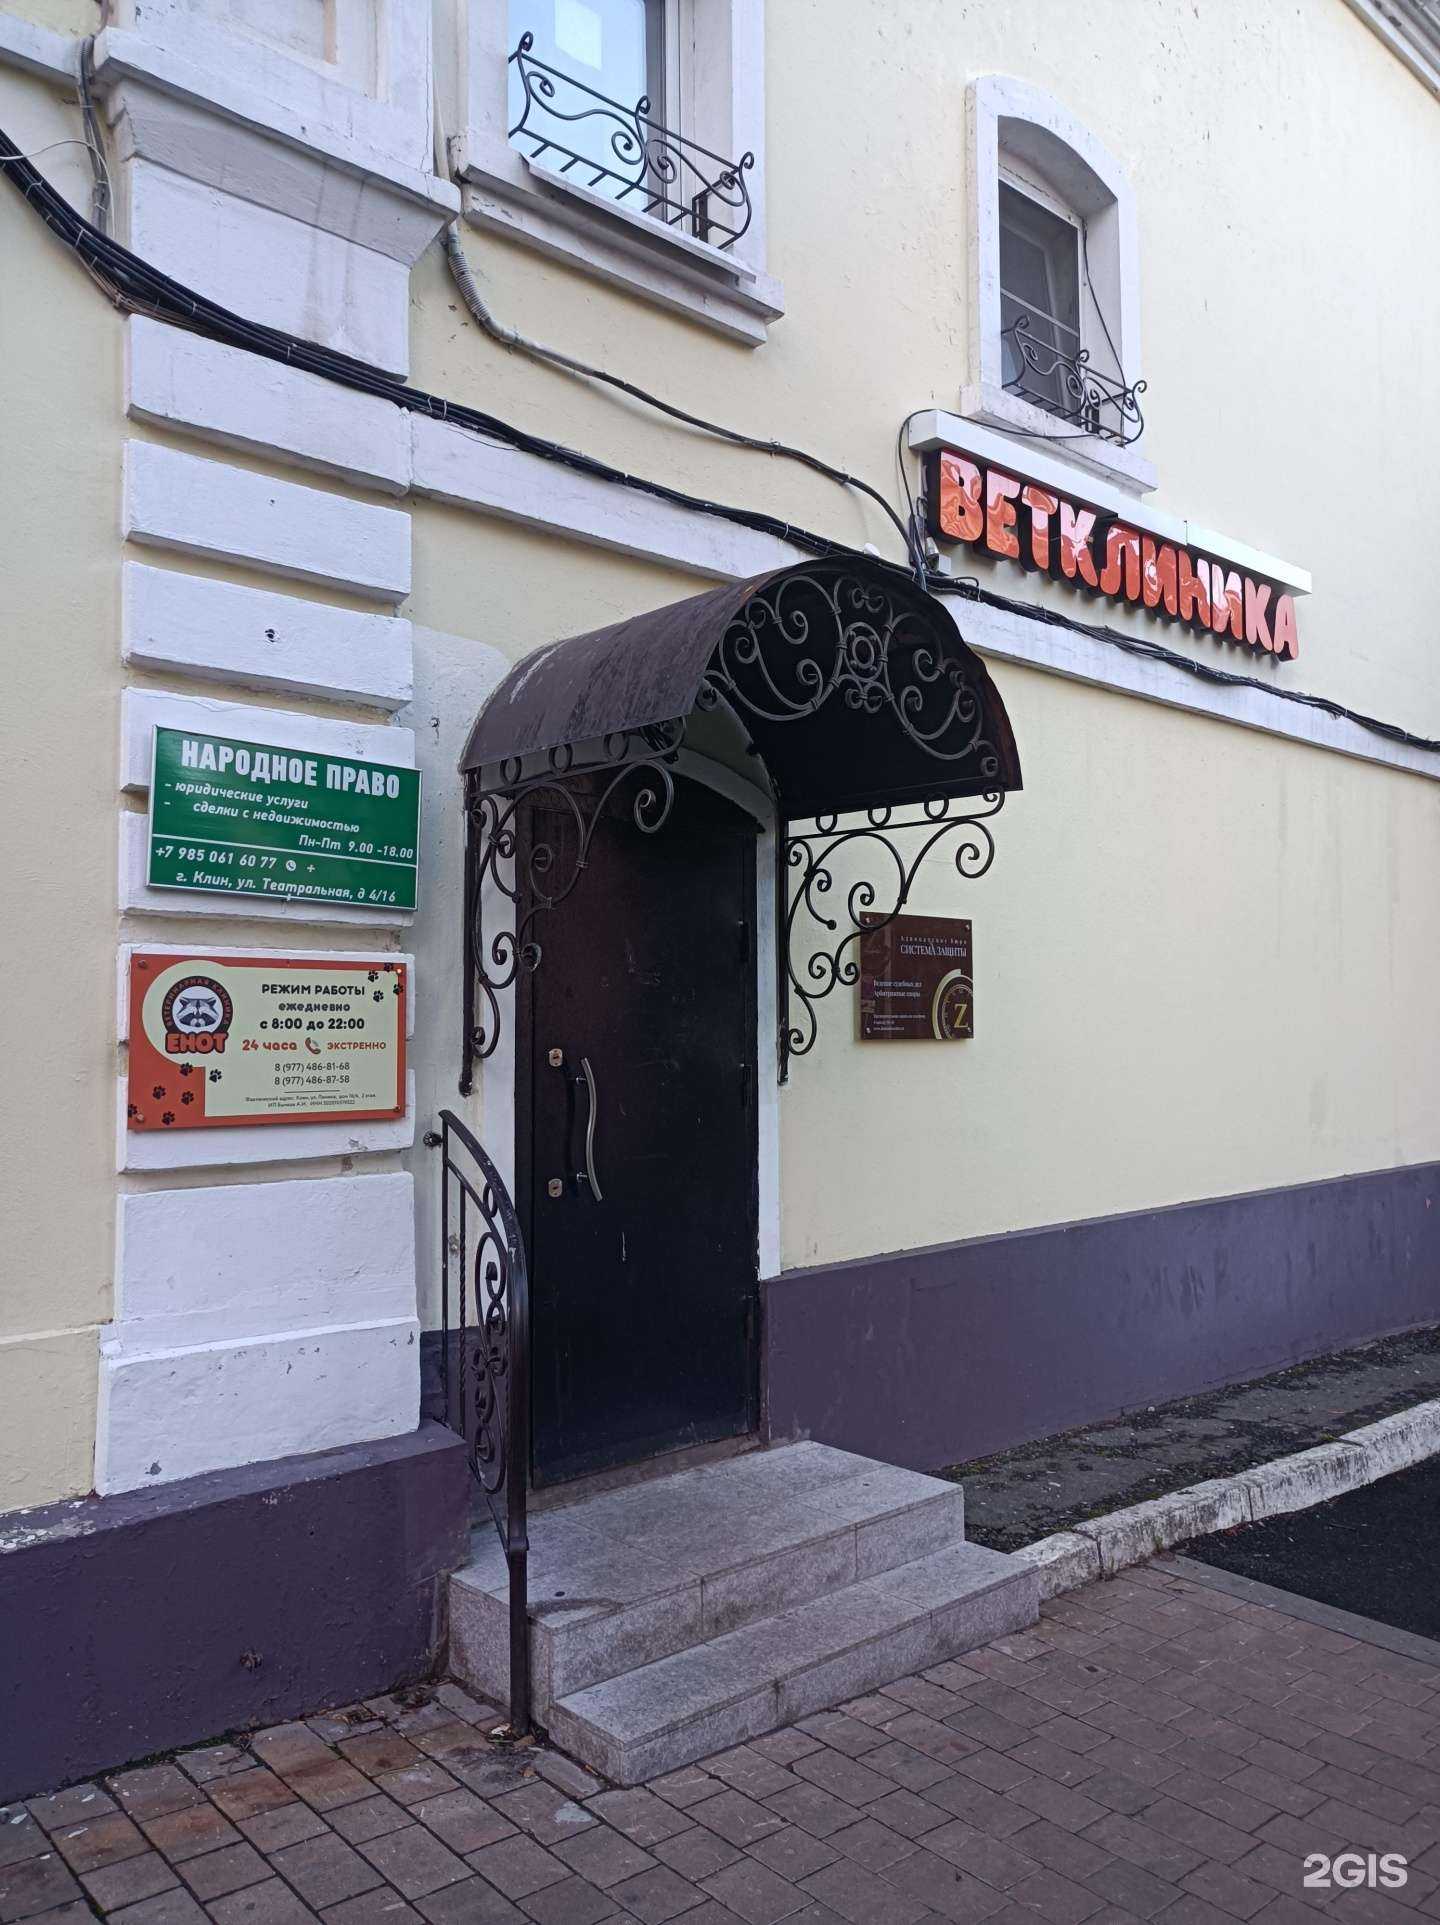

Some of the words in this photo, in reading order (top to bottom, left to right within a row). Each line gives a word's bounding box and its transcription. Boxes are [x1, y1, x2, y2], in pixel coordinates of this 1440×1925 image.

[939, 450, 1300, 660] ВЕТКЛИНИКА
[181, 739, 318, 787] НАРОДНОЕ
[326, 763, 401, 799] ПРАВО
[175, 782, 263, 803] юридические
[266, 795, 309, 810] услуги
[193, 801, 239, 817] сделки
[242, 810, 249, 818] с
[252, 810, 361, 834] недвижимостью
[299, 834, 341, 851] Пн-Пт
[348, 841, 374, 855] 9.00
[155, 846, 174, 859] +7
[178, 847, 205, 862] 985
[208, 851, 234, 865] 061
[239, 854, 256, 868] 60
[260, 857, 278, 870] 77
[176, 872, 188, 883] г.
[193, 871, 234, 888] Клин,
[235, 877, 257, 890] ул.
[262, 877, 354, 899] Театральная,
[357, 888, 365, 900] д
[368, 889, 397, 904] 4/16
[901, 942, 936, 956] СИСТЕМА
[937, 946, 967, 957] ЗАЩИТЫ
[261, 983, 311, 996] РЕЖИМ
[314, 985, 366, 997] РАБОТЫ
[278, 1002, 351, 1013] ежедневно
[953, 1003, 968, 1028] Z
[260, 1020, 267, 1030] с
[271, 1018, 303, 1030] 8:00
[306, 1020, 324, 1032] до
[328, 1018, 366, 1030] 22:00
[166, 1032, 228, 1053] ЕНОТ
[242, 1039, 259, 1051] 24
[262, 1040, 298, 1051] часа
[327, 1041, 387, 1051] ЭКСТРЕННО
[274, 1063, 281, 1072] 8
[282, 1062, 305, 1073] (977)
[306, 1062, 351, 1072] 486-81-68
[274, 1076, 281, 1086] 8
[282, 1076, 305, 1087] (977)
[306, 1074, 351, 1085] 486-87-58
